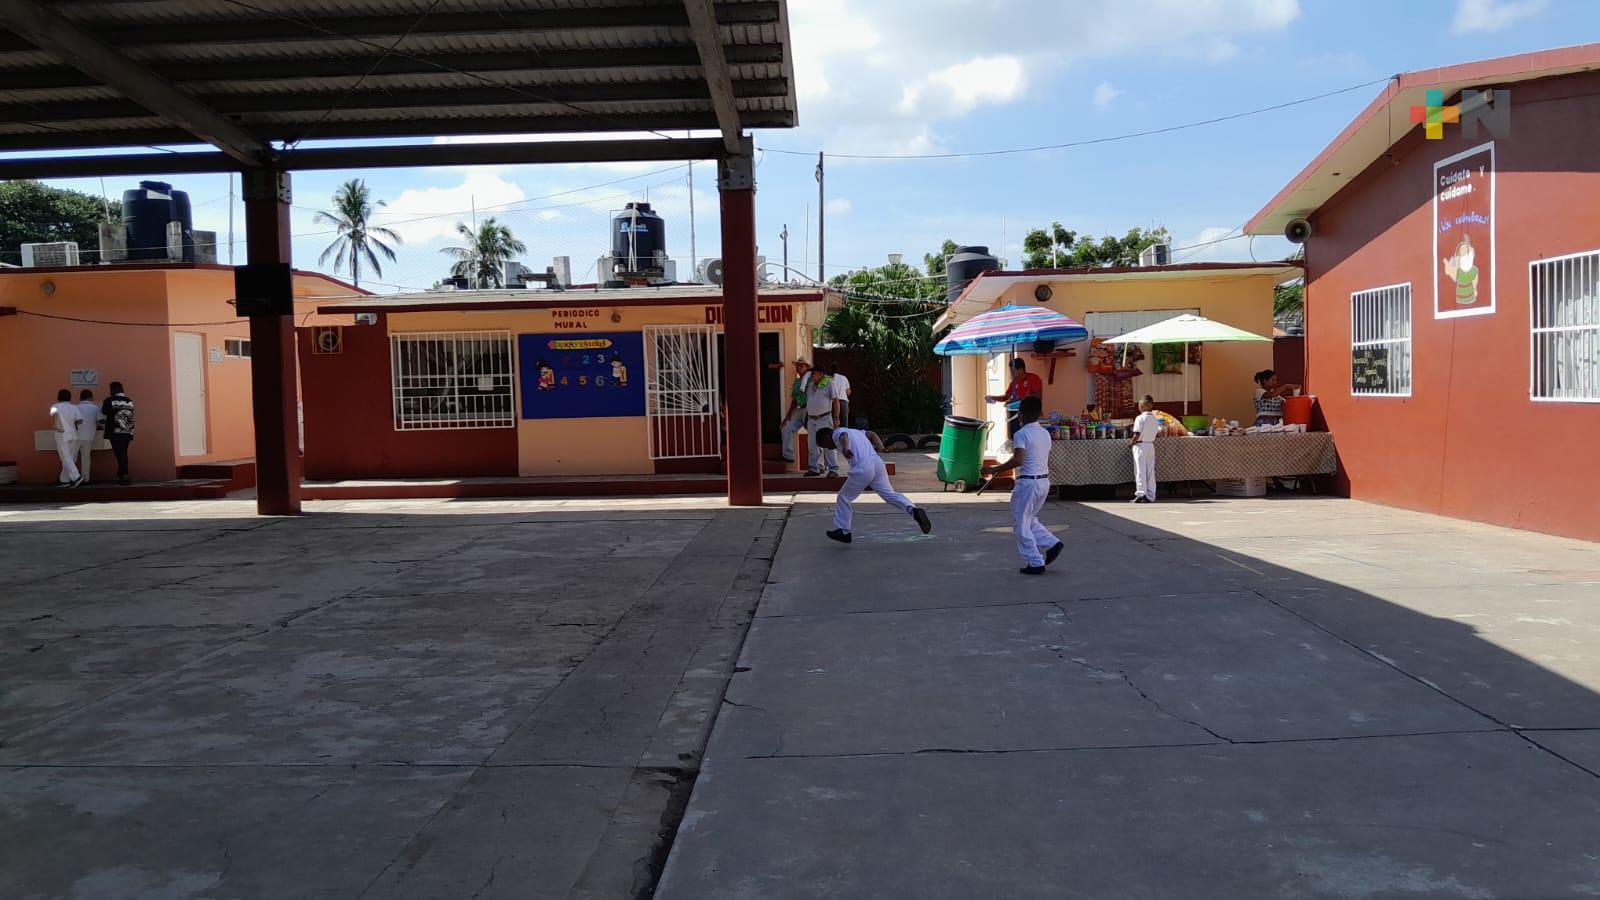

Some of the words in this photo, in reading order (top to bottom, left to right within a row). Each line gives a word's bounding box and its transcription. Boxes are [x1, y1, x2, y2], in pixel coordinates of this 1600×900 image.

[552, 309, 600, 318] PERIODICO
[705, 304, 793, 324] DICION
[554, 321, 588, 329] MURAL
[582, 354, 591, 365] 2
[597, 353, 606, 364] 3
[560, 376, 569, 386] 4
[578, 375, 588, 386] 5
[595, 375, 605, 387] 6
